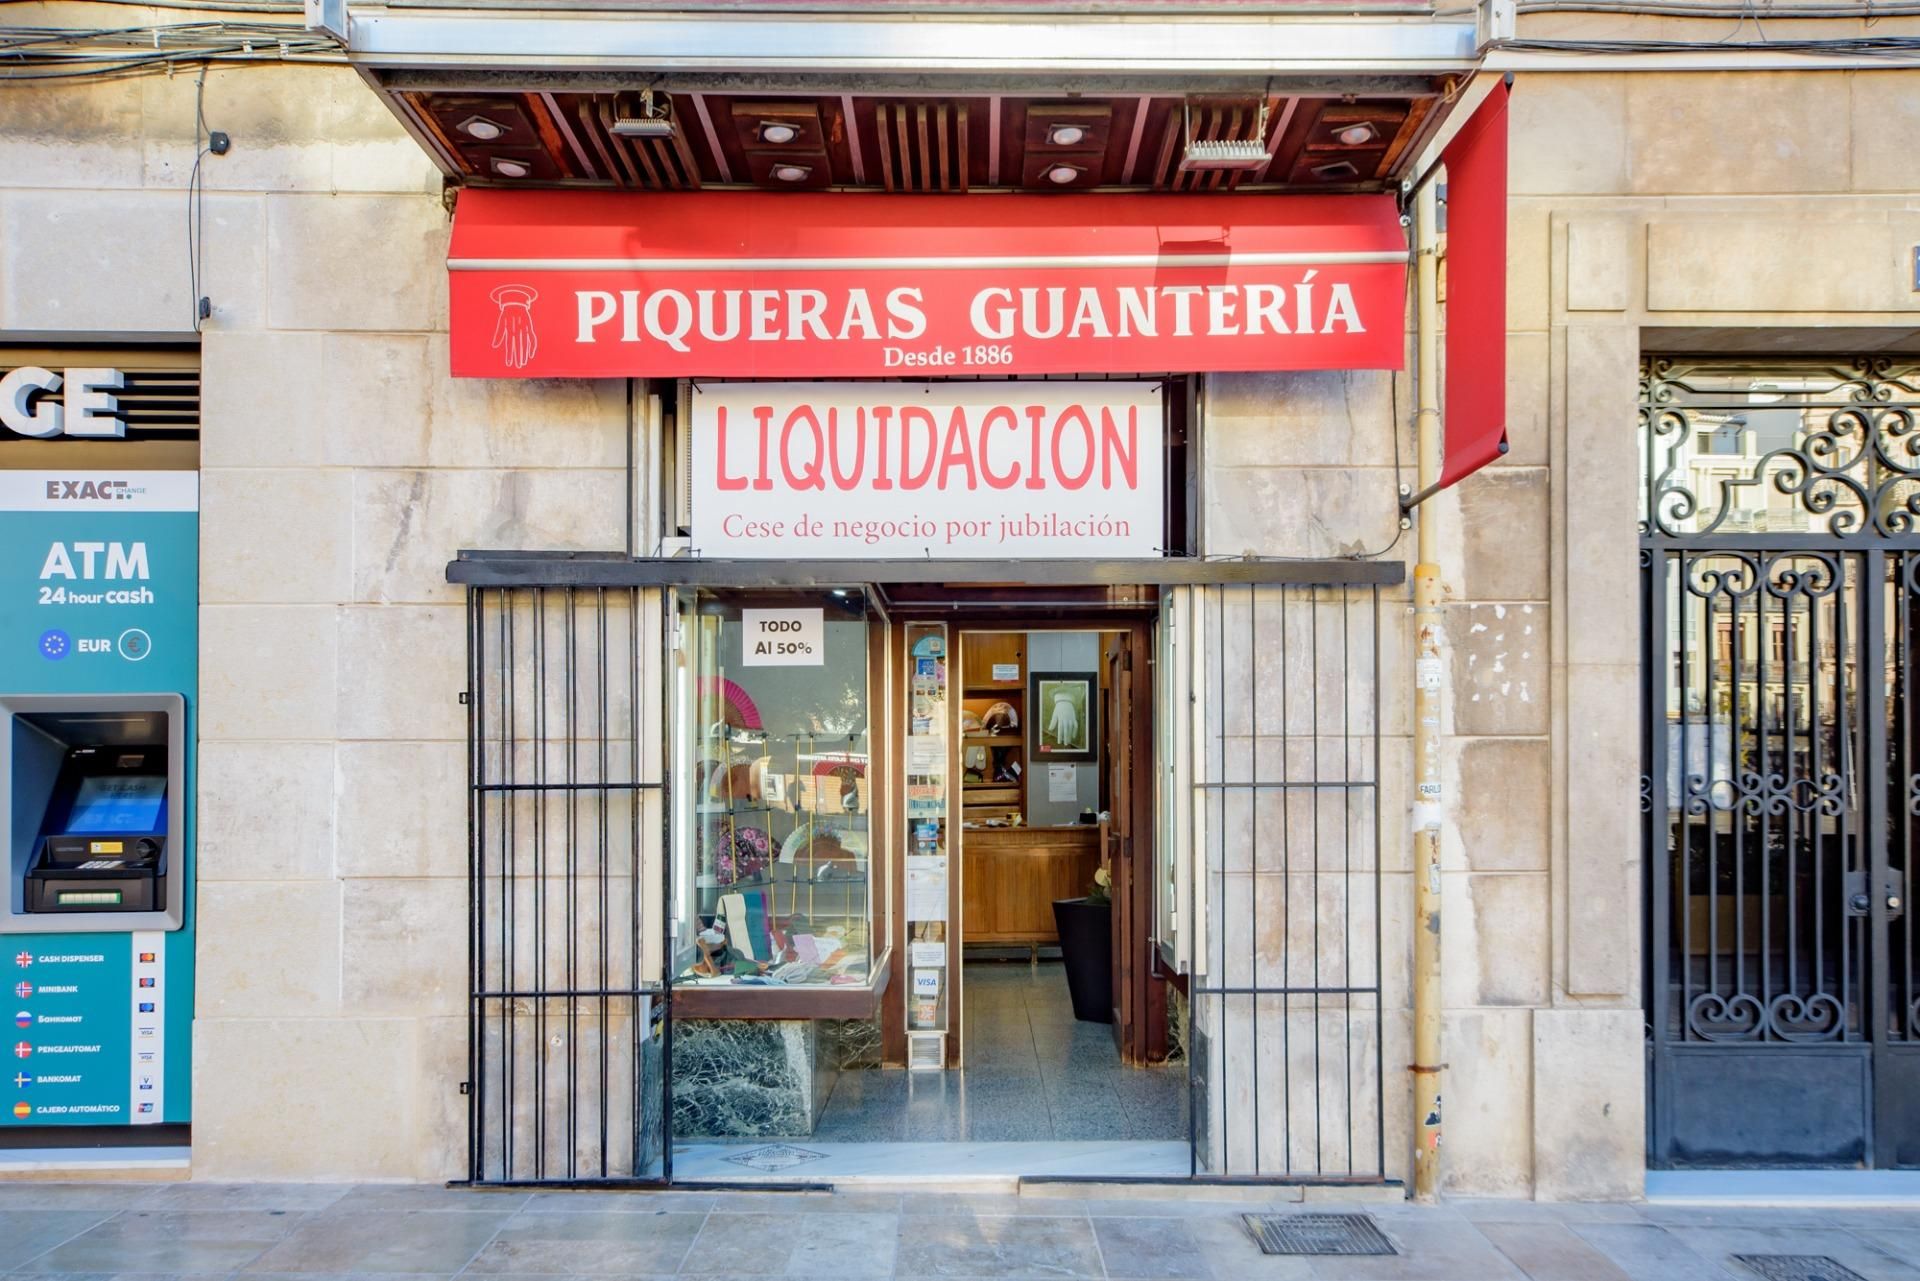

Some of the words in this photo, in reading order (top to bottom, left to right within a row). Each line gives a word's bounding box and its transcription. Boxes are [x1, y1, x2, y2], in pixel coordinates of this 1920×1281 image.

[574, 286, 928, 352] PIQUERAS
[969, 269, 1366, 341] GUANTERÍA
[883, 344, 956, 367] Desde
[961, 344, 1014, 367] 1886
[716, 403, 1138, 492] LIQUIDACION
[46, 480, 128, 500] EXACT
[723, 513, 786, 538] Cese
[793, 513, 826, 538] de
[831, 515, 937, 545] negocio
[945, 521, 990, 545] por
[996, 513, 1131, 545] jubilación
[39, 542, 150, 580] ATM
[39, 587, 67, 605] 24
[68, 591, 105, 605] hour
[106, 586, 154, 605] cash
[759, 620, 803, 633] TODO
[77, 639, 112, 653] EUR
[777, 642, 812, 655] 50%
[38, 955, 61, 963] CASH
[61, 955, 104, 963] DISPENSER
[917, 978, 937, 986] VISA
[37, 1045, 101, 1053] PENGEAUTOMAT
[37, 1075, 81, 1083] BANKOMAT
